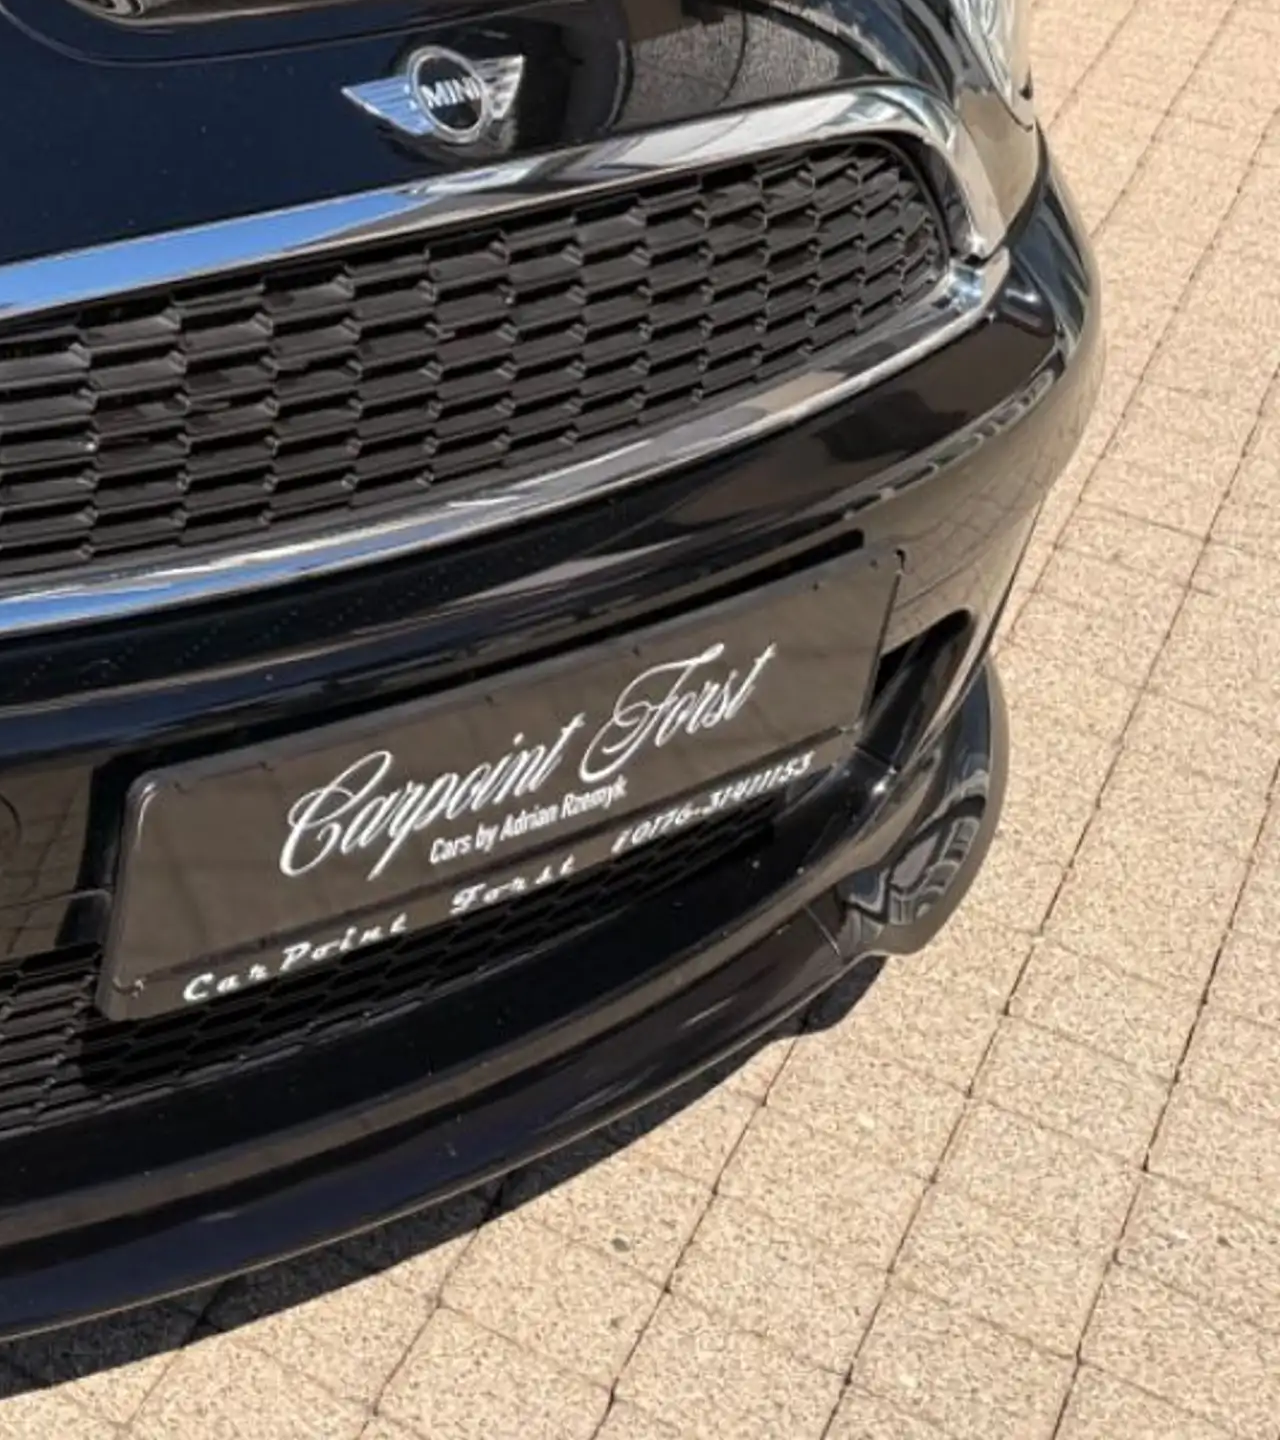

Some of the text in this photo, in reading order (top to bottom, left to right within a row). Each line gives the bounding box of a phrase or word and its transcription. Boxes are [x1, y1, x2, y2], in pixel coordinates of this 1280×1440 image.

[417, 77, 482, 109] MINI
[279, 642, 778, 882] Carpoint Forst
[429, 834, 473, 864] Cars
[475, 823, 499, 852] by
[499, 804, 559, 841] Adrian
